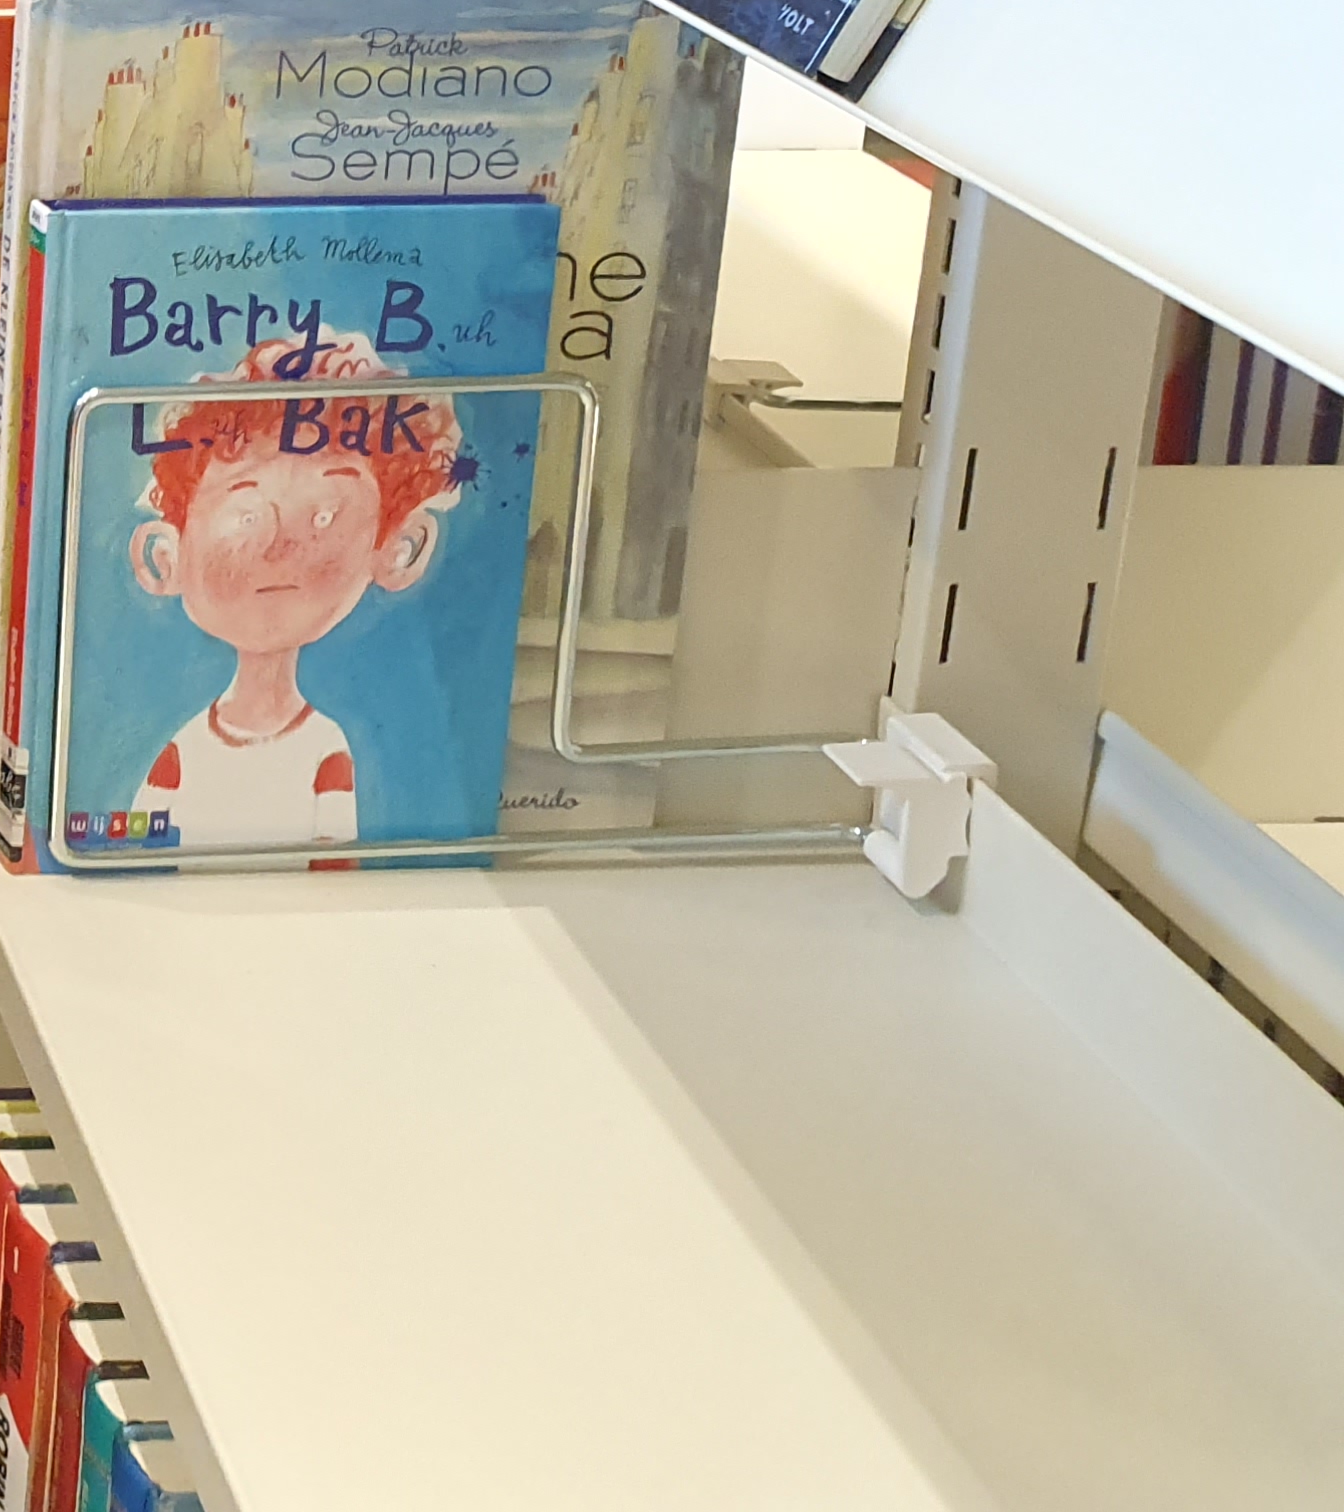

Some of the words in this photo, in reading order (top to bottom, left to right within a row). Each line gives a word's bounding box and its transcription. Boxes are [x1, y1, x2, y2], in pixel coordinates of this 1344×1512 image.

[359, 26, 468, 57] Patrick
[274, 40, 553, 100] Modiano
[315, 108, 500, 148] Jean-Jacques
[290, 132, 521, 196] Sempé
[172, 235, 309, 278] Elisabeth
[320, 234, 426, 268] Mollema
[109, 274, 340, 382] Barry
[375, 278, 449, 355] B.
[499, 786, 582, 811] uerido
